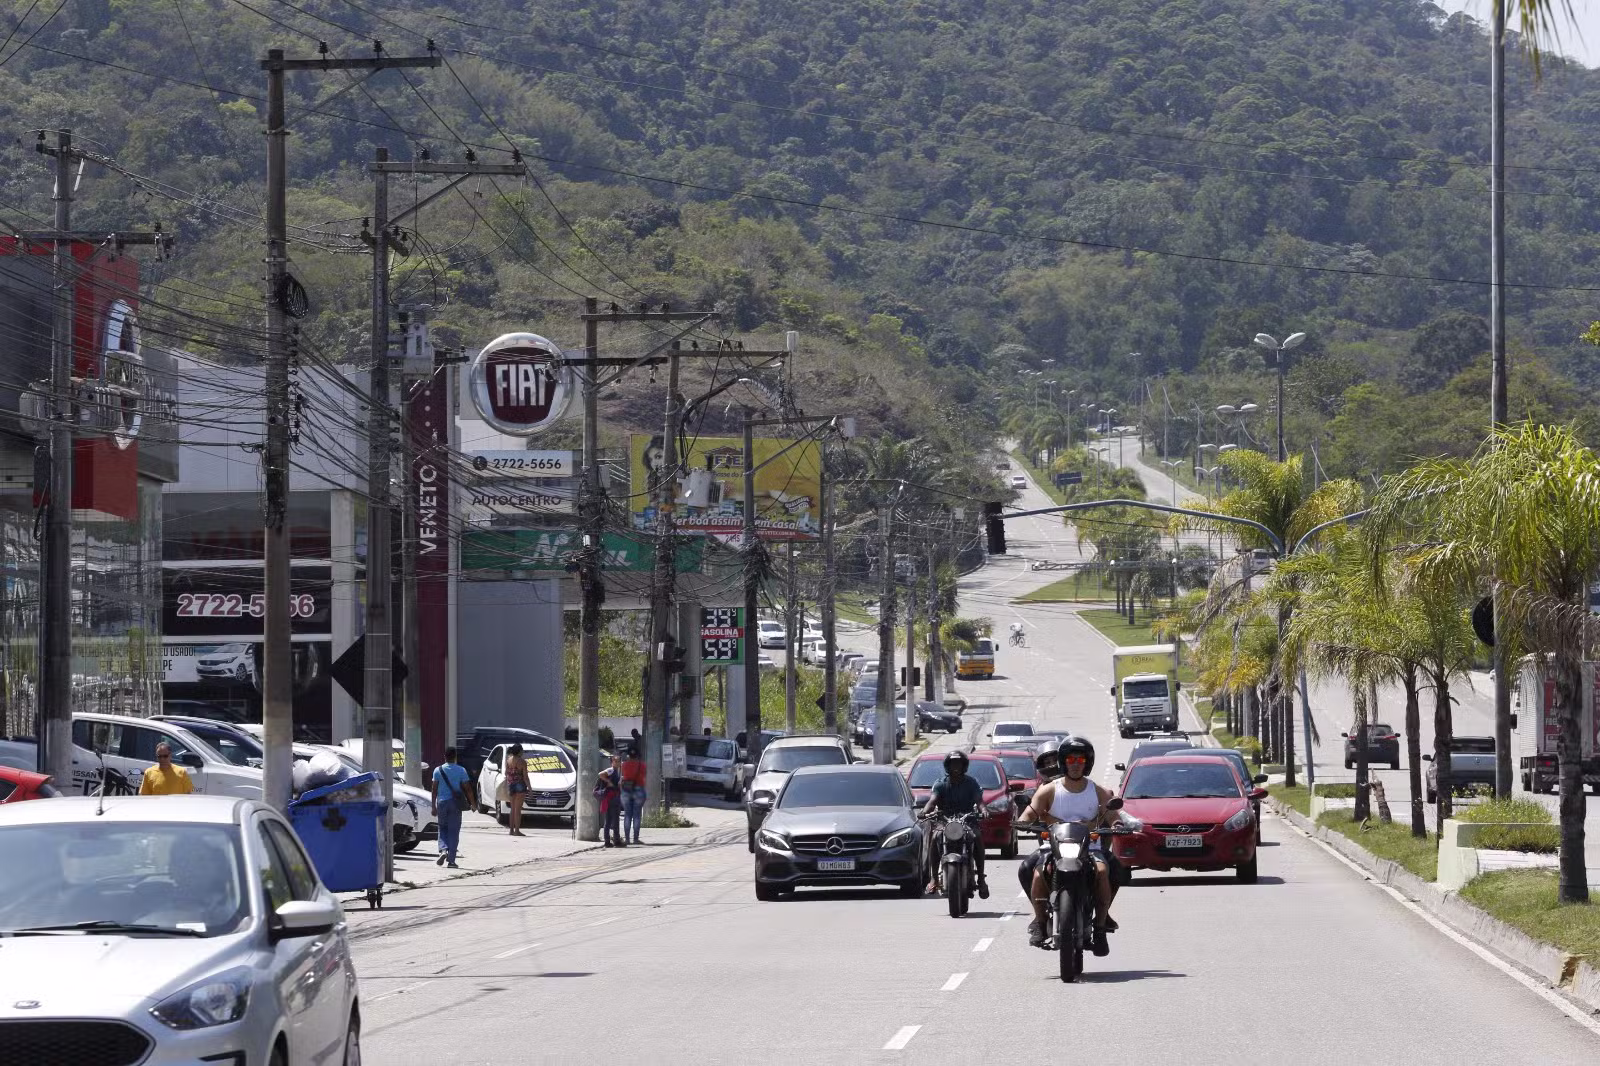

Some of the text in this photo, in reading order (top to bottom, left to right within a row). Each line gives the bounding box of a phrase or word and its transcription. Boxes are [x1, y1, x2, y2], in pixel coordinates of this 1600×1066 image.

[495, 363, 546, 406] FIAT
[493, 458, 562, 469] 2722-5656
[472, 495, 562, 506] AUTOCENTRO
[419, 465, 437, 555] VENETO
[689, 516, 708, 526] boa
[711, 516, 740, 526] assim
[772, 519, 801, 530] casa!
[170, 647, 196, 657] USADO!
[1167, 838, 1202, 847] KZF-7923
